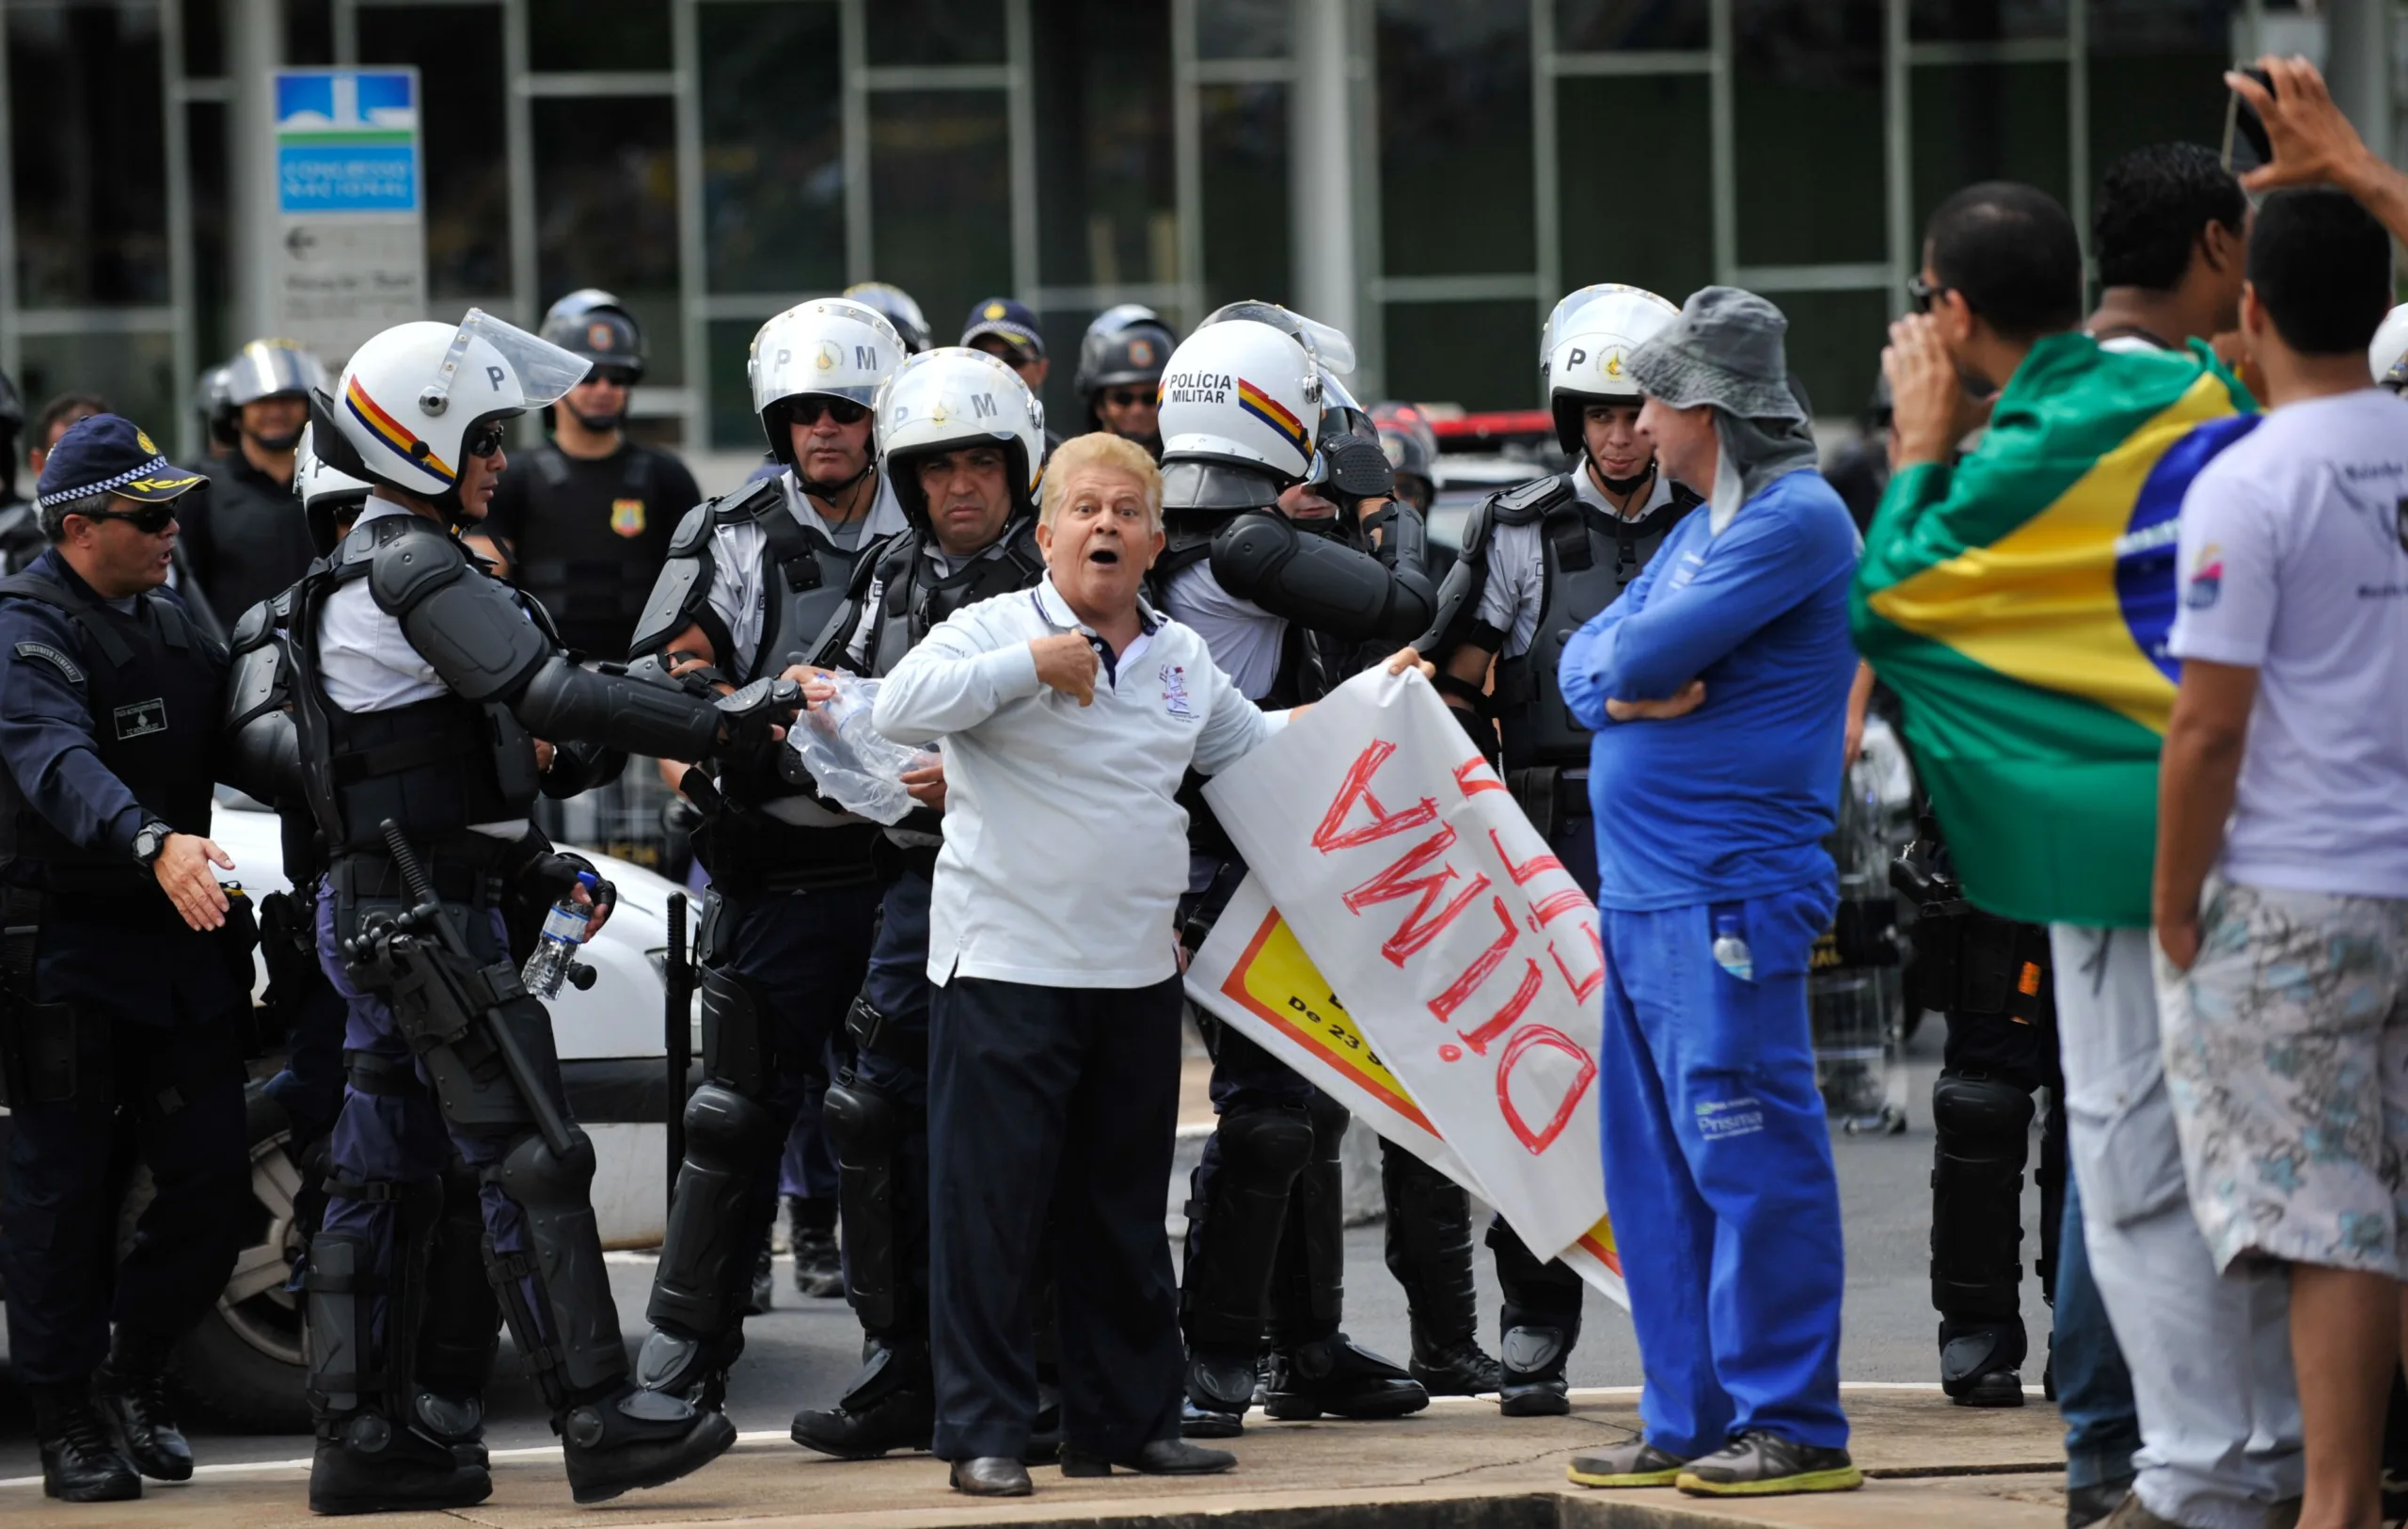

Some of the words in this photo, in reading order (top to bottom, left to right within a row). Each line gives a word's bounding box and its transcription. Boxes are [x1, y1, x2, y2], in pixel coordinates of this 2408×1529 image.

[774, 349, 791, 374] P
[855, 345, 878, 371] M
[1566, 347, 1587, 372] P
[486, 366, 505, 391] P
[1170, 370, 1232, 390] POLÍCIA
[1172, 389, 1226, 405] MILITAR
[894, 406, 909, 432] P
[971, 392, 998, 419] M
[1312, 738, 1598, 1156] DILMA
[1288, 995, 1322, 1024] De
[1328, 1024, 1360, 1049] 23
[1697, 1111, 1764, 1133] Prisma
